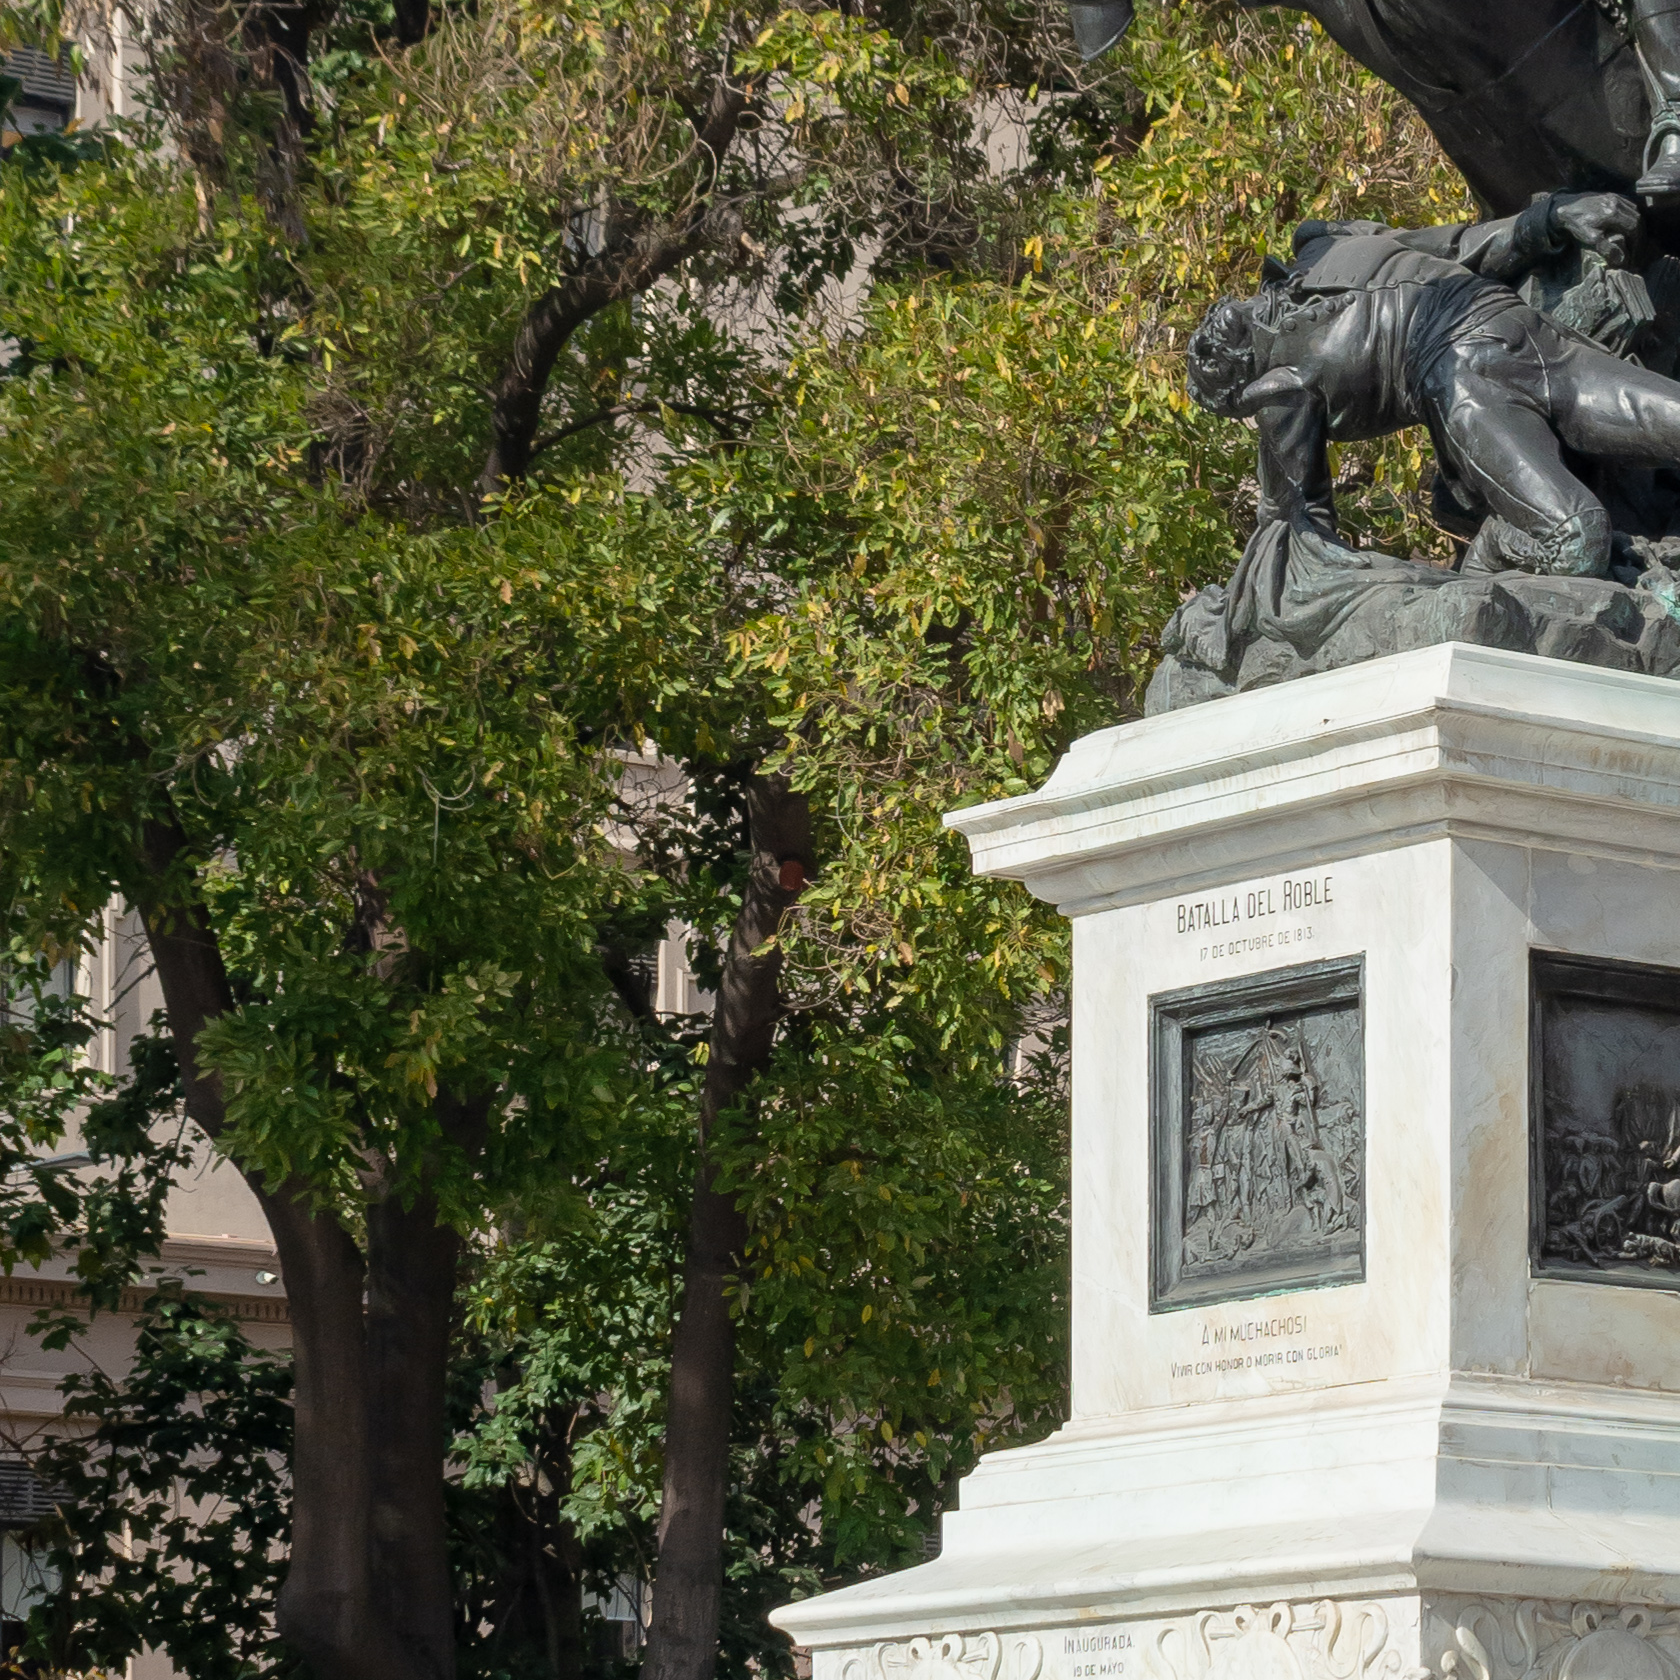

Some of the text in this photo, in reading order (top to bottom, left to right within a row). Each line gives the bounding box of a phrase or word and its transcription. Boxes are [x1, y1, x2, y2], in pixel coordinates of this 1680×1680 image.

[1177, 876, 1333, 934] BATALLA DEL ROBLE
[1200, 947, 1208, 962] 17
[1211, 943, 1224, 959] DE
[1228, 933, 1274, 955] OCTUBRE
[1277, 930, 1290, 946] DE
[1214, 1325, 1227, 1345] MI
[1195, 1361, 1212, 1375] CON
[1215, 1357, 1244, 1372] HONOR
[1246, 1356, 1252, 1368] O
[1254, 1352, 1283, 1367] MORIR
[1286, 1349, 1304, 1363] CON
[1084, 1664, 1096, 1676] DE
[1100, 1662, 1124, 1675] MAYO
